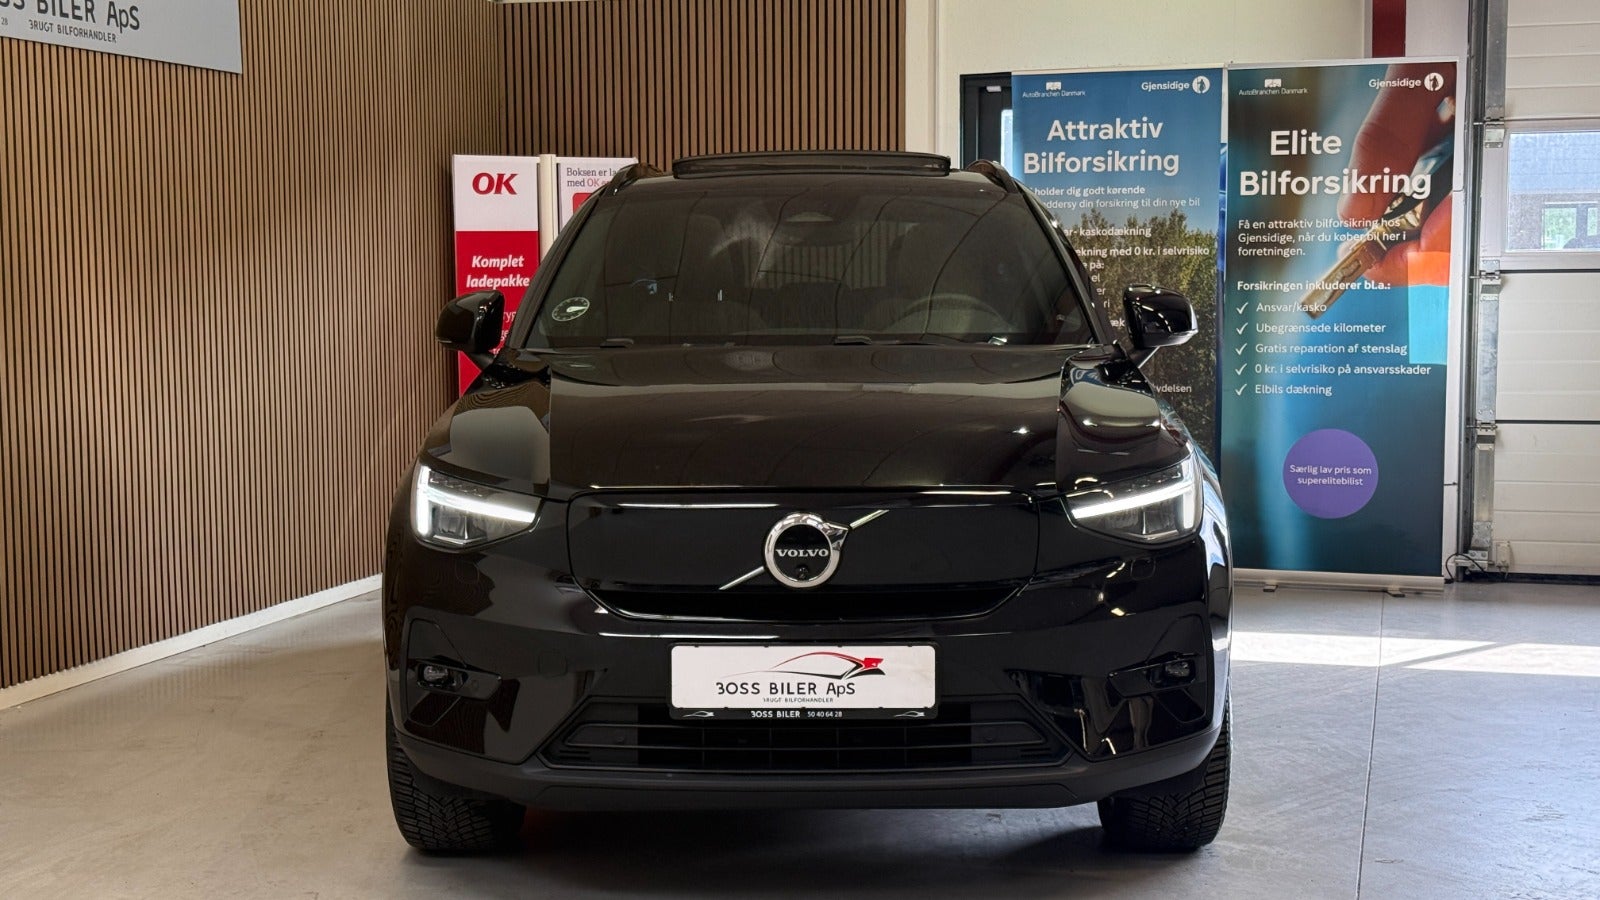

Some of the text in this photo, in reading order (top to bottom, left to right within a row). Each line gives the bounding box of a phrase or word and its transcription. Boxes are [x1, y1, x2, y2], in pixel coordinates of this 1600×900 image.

[107, 1, 140, 34] ApS
[57, 24, 117, 43] BILFORHANDLER
[1141, 81, 1190, 91] Gjensidige
[1369, 78, 1421, 89] Gjensidige
[1047, 116, 1163, 141] Attraktiv
[1270, 129, 1342, 156] Elite
[1024, 149, 1179, 176] Bilforsikring
[566, 168, 597, 177] Boksen
[598, 169, 607, 177] er
[472, 172, 518, 195] OK
[567, 178, 586, 187] med
[587, 179, 600, 187] OK
[1240, 167, 1431, 199] Bilforsikring
[1034, 187, 1065, 196] holder
[1066, 187, 1081, 197] dig
[1083, 187, 1105, 197] godt
[1107, 186, 1145, 195] kørende
[1079, 199, 1093, 208] din
[1096, 199, 1139, 209] forsikring
[1141, 199, 1151, 207] til
[1153, 199, 1168, 207] din
[1170, 200, 1187, 209] nye
[1189, 198, 1200, 206] bil
[1238, 217, 1401, 229] Få en attraktiv bilforsikring hos
[1080, 227, 1151, 237] kaskodækning
[1238, 234, 1296, 244] Gjensidige,
[1298, 233, 1315, 242] når
[1318, 233, 1331, 242] du
[1334, 232, 1364, 241] køber
[1367, 232, 1380, 241] bil
[1382, 231, 1400, 241] her
[1110, 247, 1132, 256] med
[1134, 247, 1141, 255] 0
[1143, 247, 1156, 255] kr.
[1163, 246, 1209, 256] selvrisiko
[1238, 246, 1306, 257] forretningen.
[472, 255, 524, 271] Komplet
[466, 274, 530, 290] ladepakke
[1237, 280, 1303, 291] Forsikringen
[1305, 280, 1361, 290] inkluderer
[1256, 302, 1327, 313] Ansvar/kasko
[1256, 323, 1386, 334] Ubegrænsede kilometer
[1255, 343, 1407, 355] Gratis reparation af stenslag
[1255, 364, 1262, 373] 0
[1264, 364, 1277, 373] kr.
[1286, 364, 1335, 374] selvrisiko
[1337, 364, 1350, 376] på
[1353, 365, 1431, 375] ansvarsskader
[1255, 384, 1332, 396] Elbils dækning
[1289, 464, 1372, 475] Særlig lav pris som
[1297, 477, 1364, 486] superelitebilist
[776, 549, 829, 557] VOLVO
[769, 682, 817, 695] BILER
[826, 682, 856, 698] ApS
[776, 710, 801, 718] BILER
